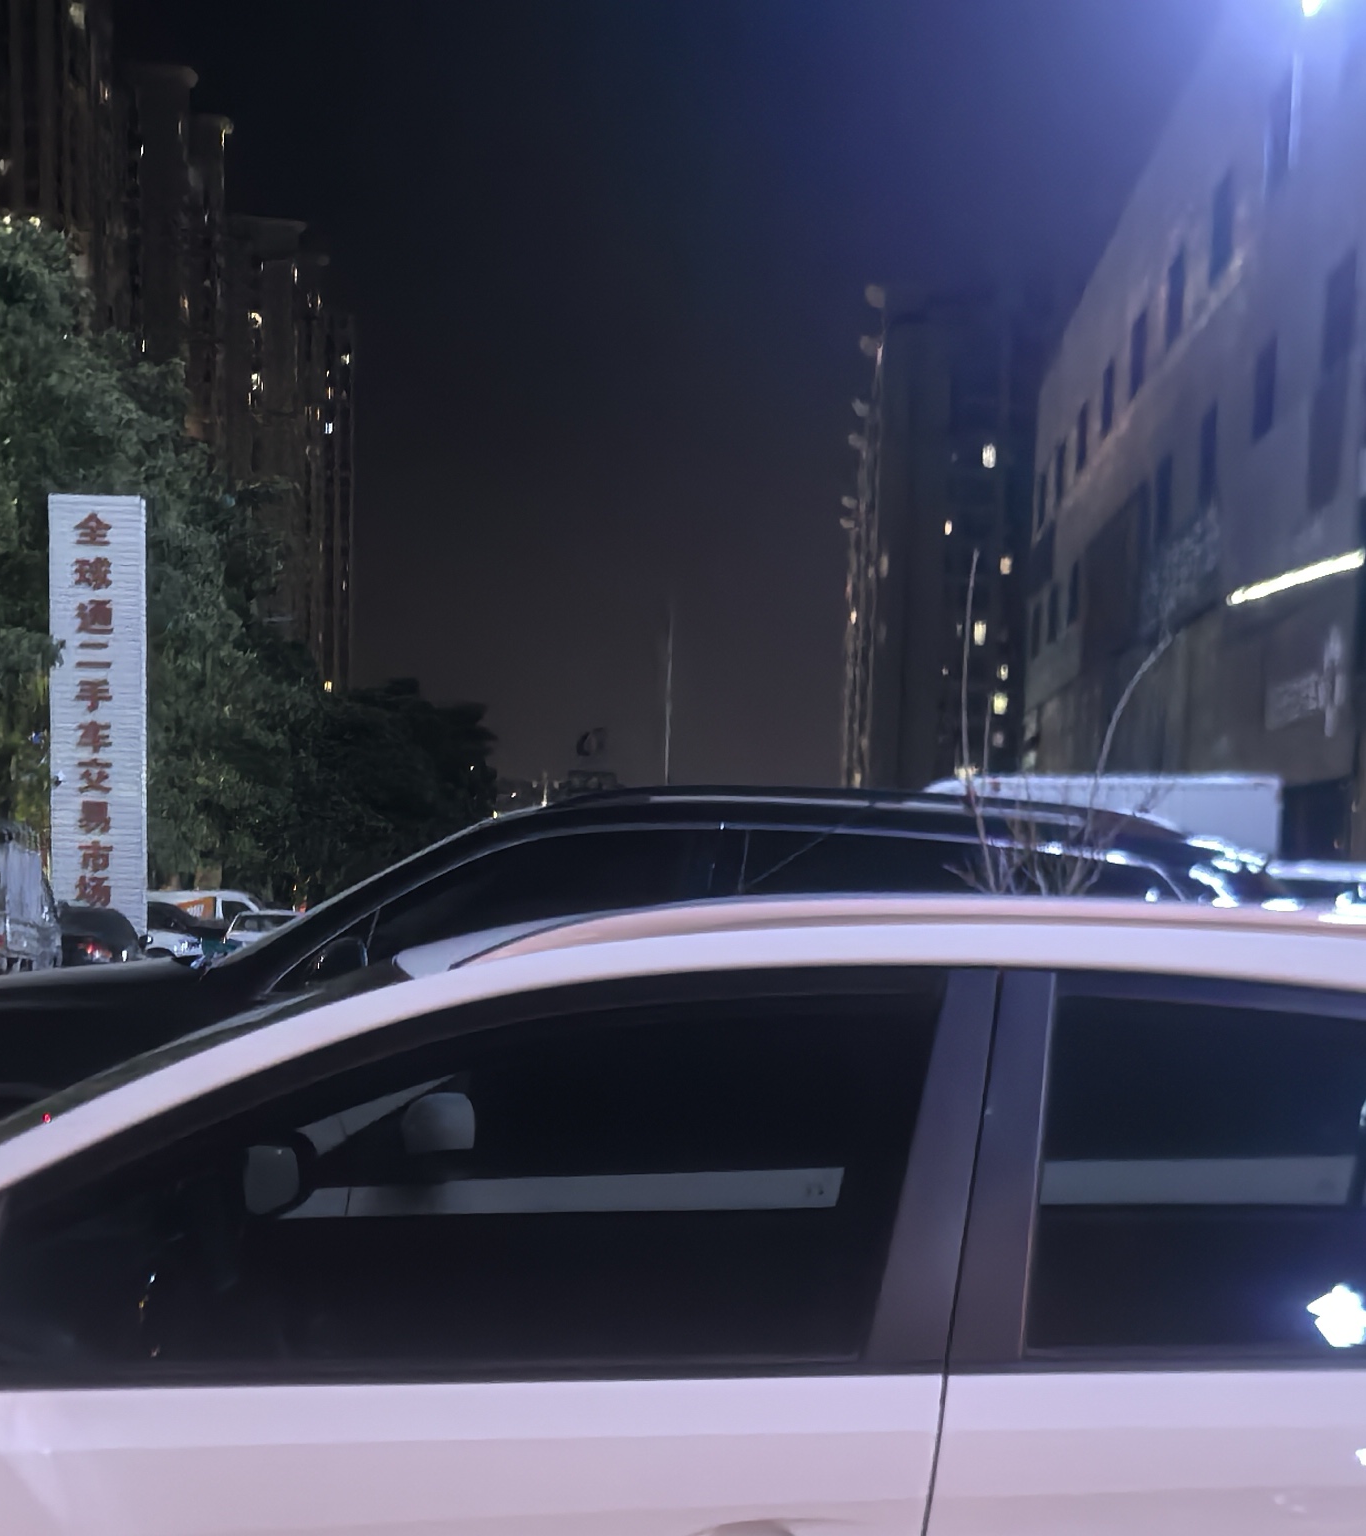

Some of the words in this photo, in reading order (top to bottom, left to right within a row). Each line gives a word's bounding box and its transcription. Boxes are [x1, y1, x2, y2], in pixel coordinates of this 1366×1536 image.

[73, 511, 114, 907] 全球通二手车交易市场
